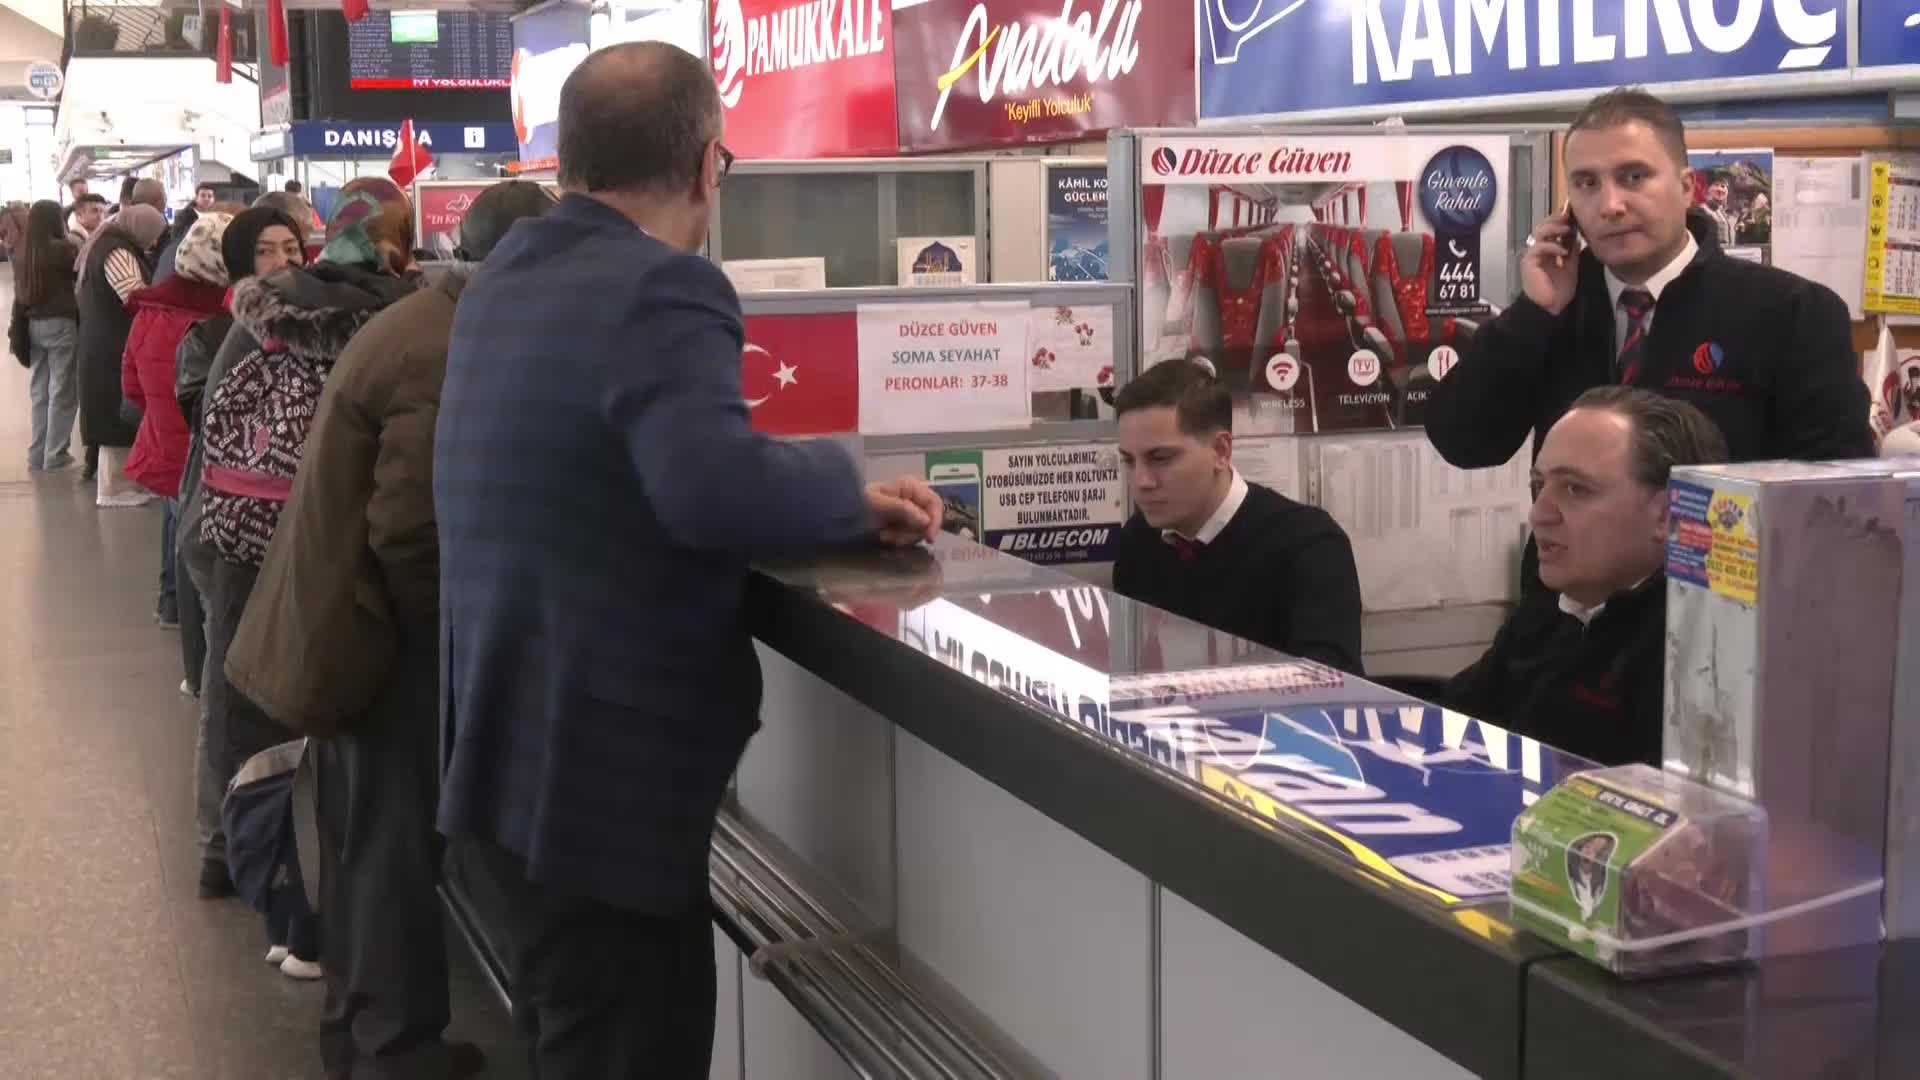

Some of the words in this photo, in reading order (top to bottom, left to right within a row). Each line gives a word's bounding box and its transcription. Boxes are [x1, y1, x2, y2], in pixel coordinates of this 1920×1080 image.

[746, 0, 885, 76] PAMUKKALE
[929, 0, 1142, 131] Anadolu
[324, 130, 433, 148] DANIŞA
[1178, 149, 1261, 176] Düzce
[1268, 147, 1351, 176] Güven
[1440, 263, 1474, 282] 444
[1440, 285, 1456, 298] 67
[1459, 284, 1474, 298] 81
[899, 321, 945, 337] DÜZCE
[948, 320, 997, 337] GÜVEN
[892, 350, 935, 364] SOMA
[939, 348, 1000, 363] SEYAHAT
[885, 376, 963, 391] PERONLAR:
[971, 374, 1008, 388] 37-38
[1008, 455, 1034, 468] SAYIN
[1035, 451, 1098, 466] YOLCULARIMIZ
[985, 470, 1055, 488] OTOBÜSÜMÜZDE
[1056, 470, 1074, 484] HER
[1075, 468, 1119, 483] KOLTUKTA
[999, 493, 1017, 506] USB
[1019, 492, 1036, 505] CEP
[1037, 489, 1081, 504] TELEFONU
[1017, 508, 1090, 524] BULUNMAKTADIR.
[1013, 528, 1110, 551] BLUECOM
